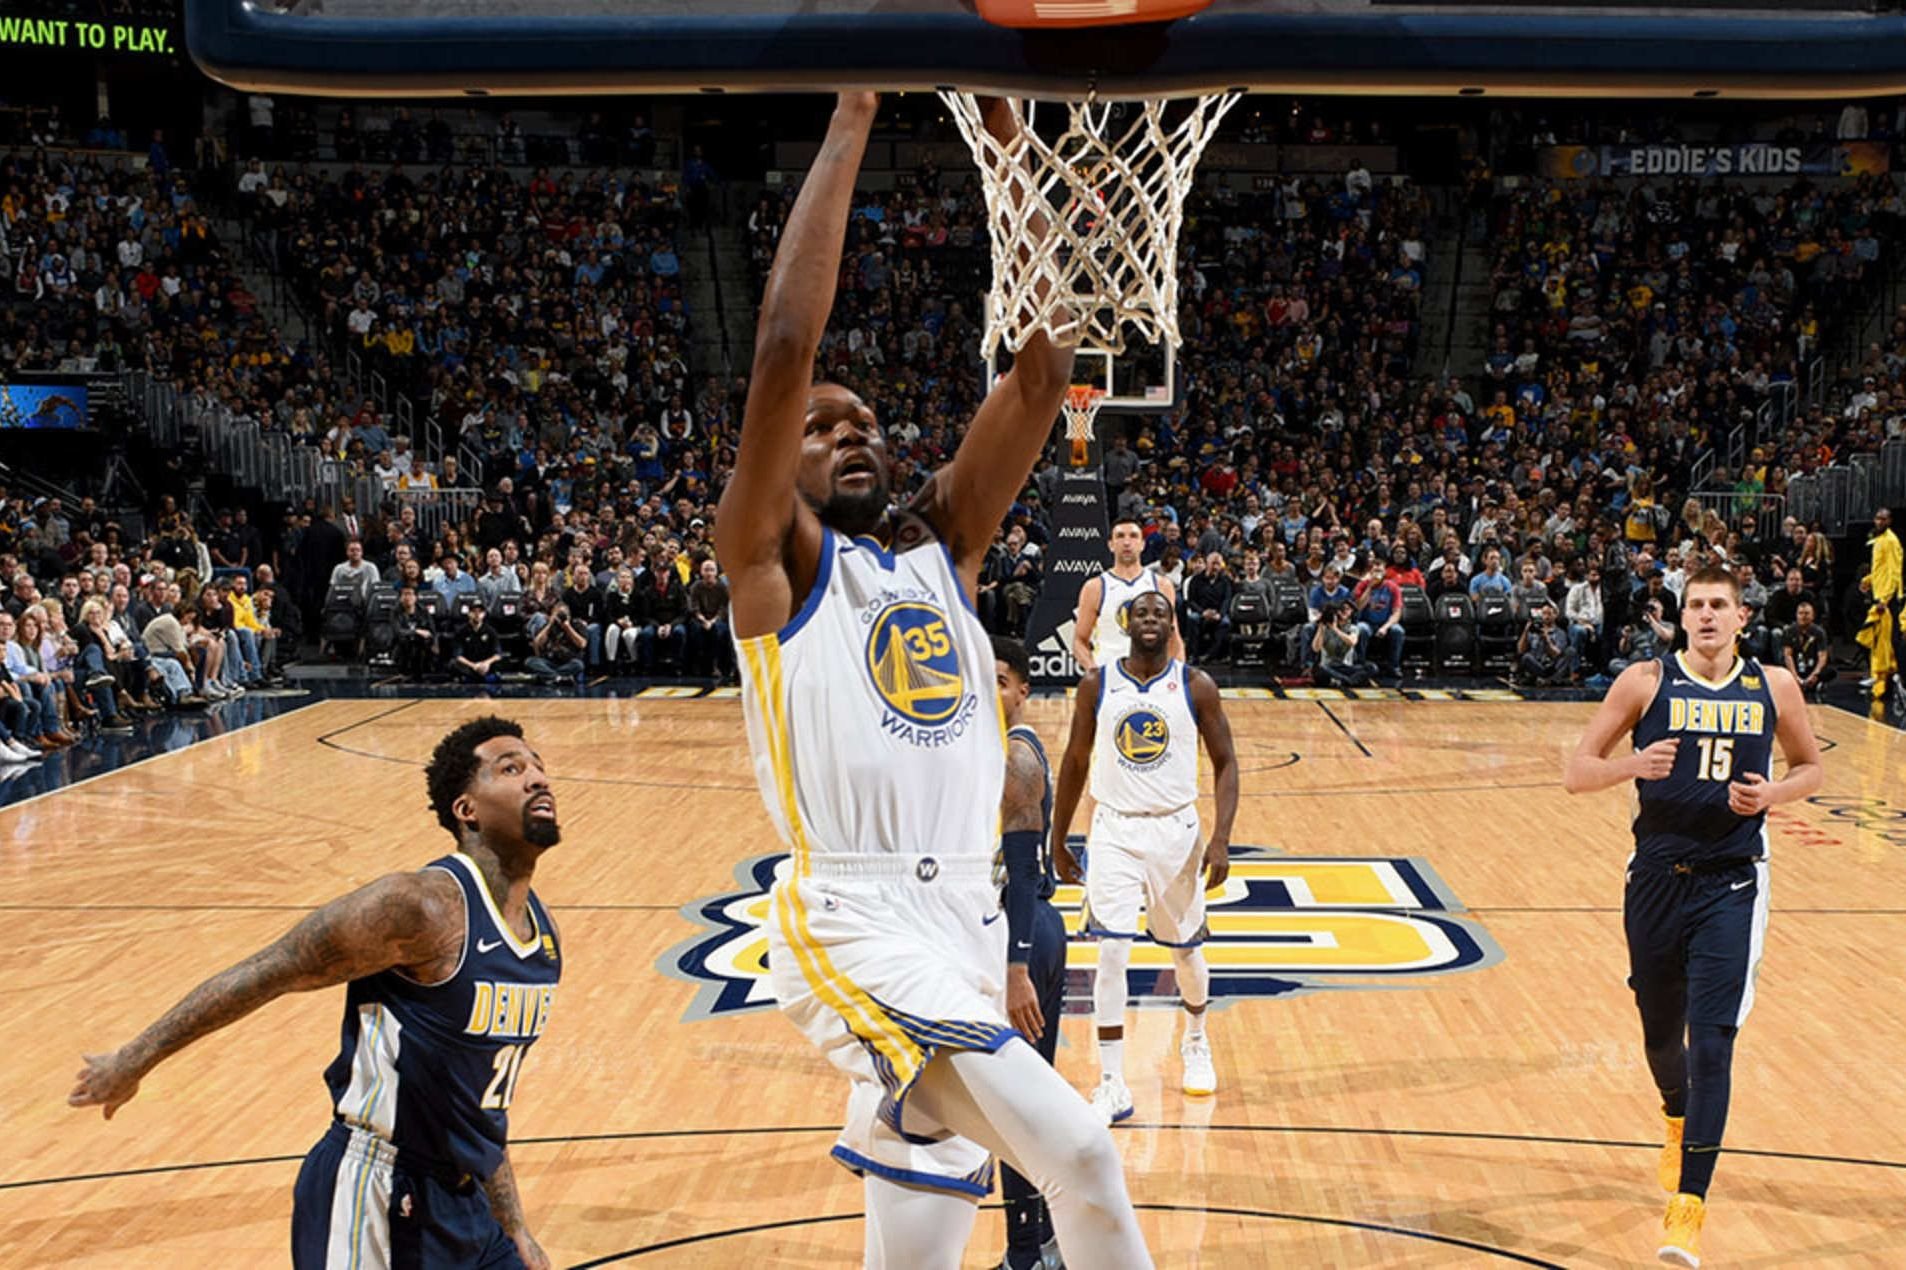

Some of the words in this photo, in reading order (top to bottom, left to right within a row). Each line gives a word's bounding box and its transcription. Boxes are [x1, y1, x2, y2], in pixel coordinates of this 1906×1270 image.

[0, 17, 68, 46] WANT
[75, 23, 106, 48] TO
[113, 25, 174, 53] PLAY.
[1630, 145, 1732, 174] EDDIE'S
[1738, 147, 1801, 173] KIDS
[1062, 493, 1098, 506] AVAYA
[1058, 527, 1100, 541] AVAYA
[1053, 560, 1104, 576] AVAYA
[903, 620, 951, 662] 35
[880, 693, 978, 748] WARRIORS
[1142, 720, 1165, 737] 23
[1668, 697, 1765, 735] DENVER
[1697, 737, 1735, 781] 15
[464, 981, 558, 1037] DENVE
